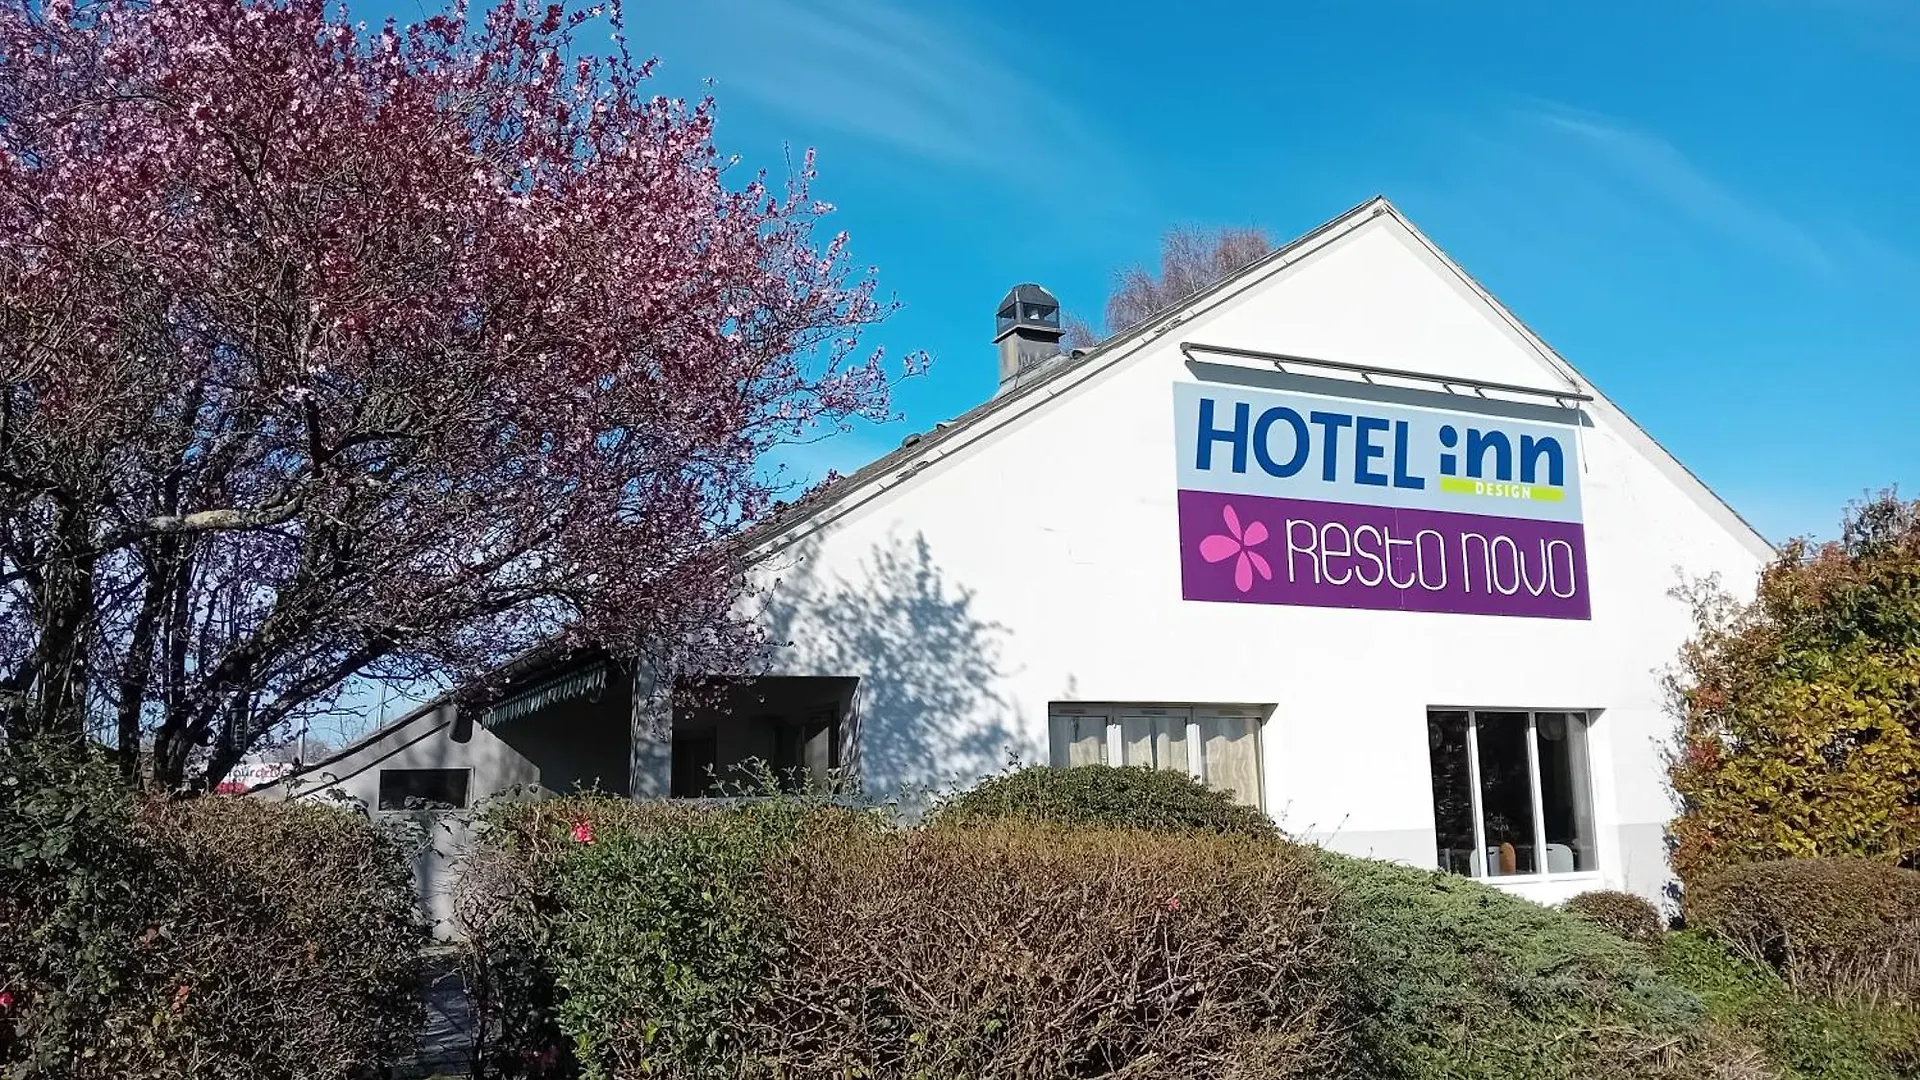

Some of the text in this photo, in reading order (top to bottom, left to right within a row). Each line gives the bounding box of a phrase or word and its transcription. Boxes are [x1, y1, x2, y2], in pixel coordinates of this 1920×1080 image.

[1196, 398, 1564, 490] HOTEL inn
[1475, 481, 1531, 499] DESIGN
[1286, 518, 1576, 599] Resto novo
